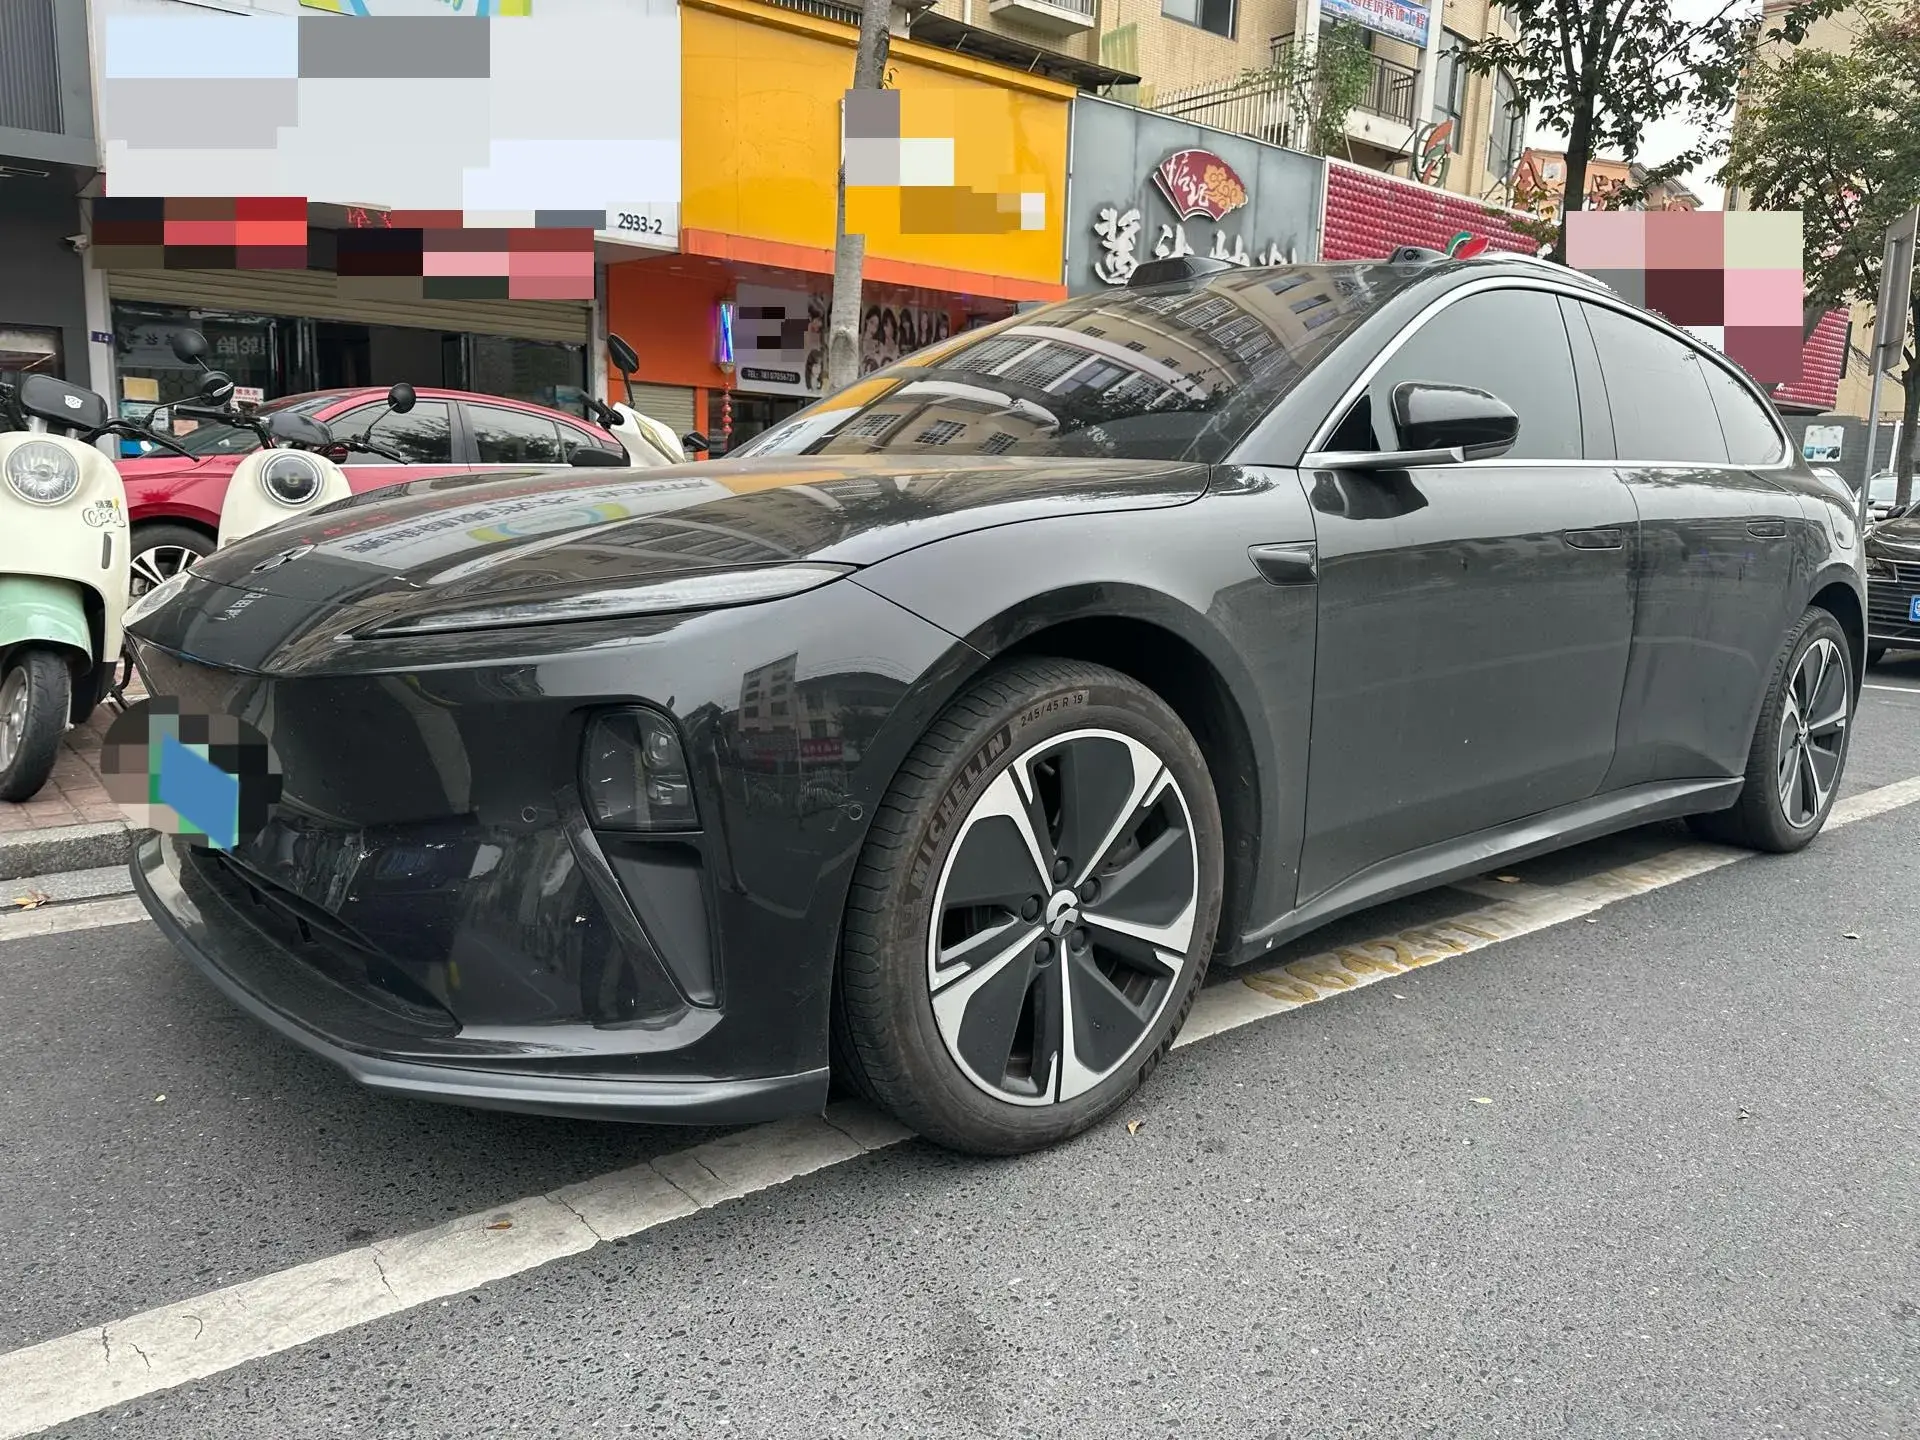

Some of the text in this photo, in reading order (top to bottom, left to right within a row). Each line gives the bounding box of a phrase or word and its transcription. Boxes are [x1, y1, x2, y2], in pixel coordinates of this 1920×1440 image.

[618, 212, 662, 235] 2933-2
[1021, 694, 1083, 728] 245/45 R 19
[909, 733, 1006, 891] MICHELIN
